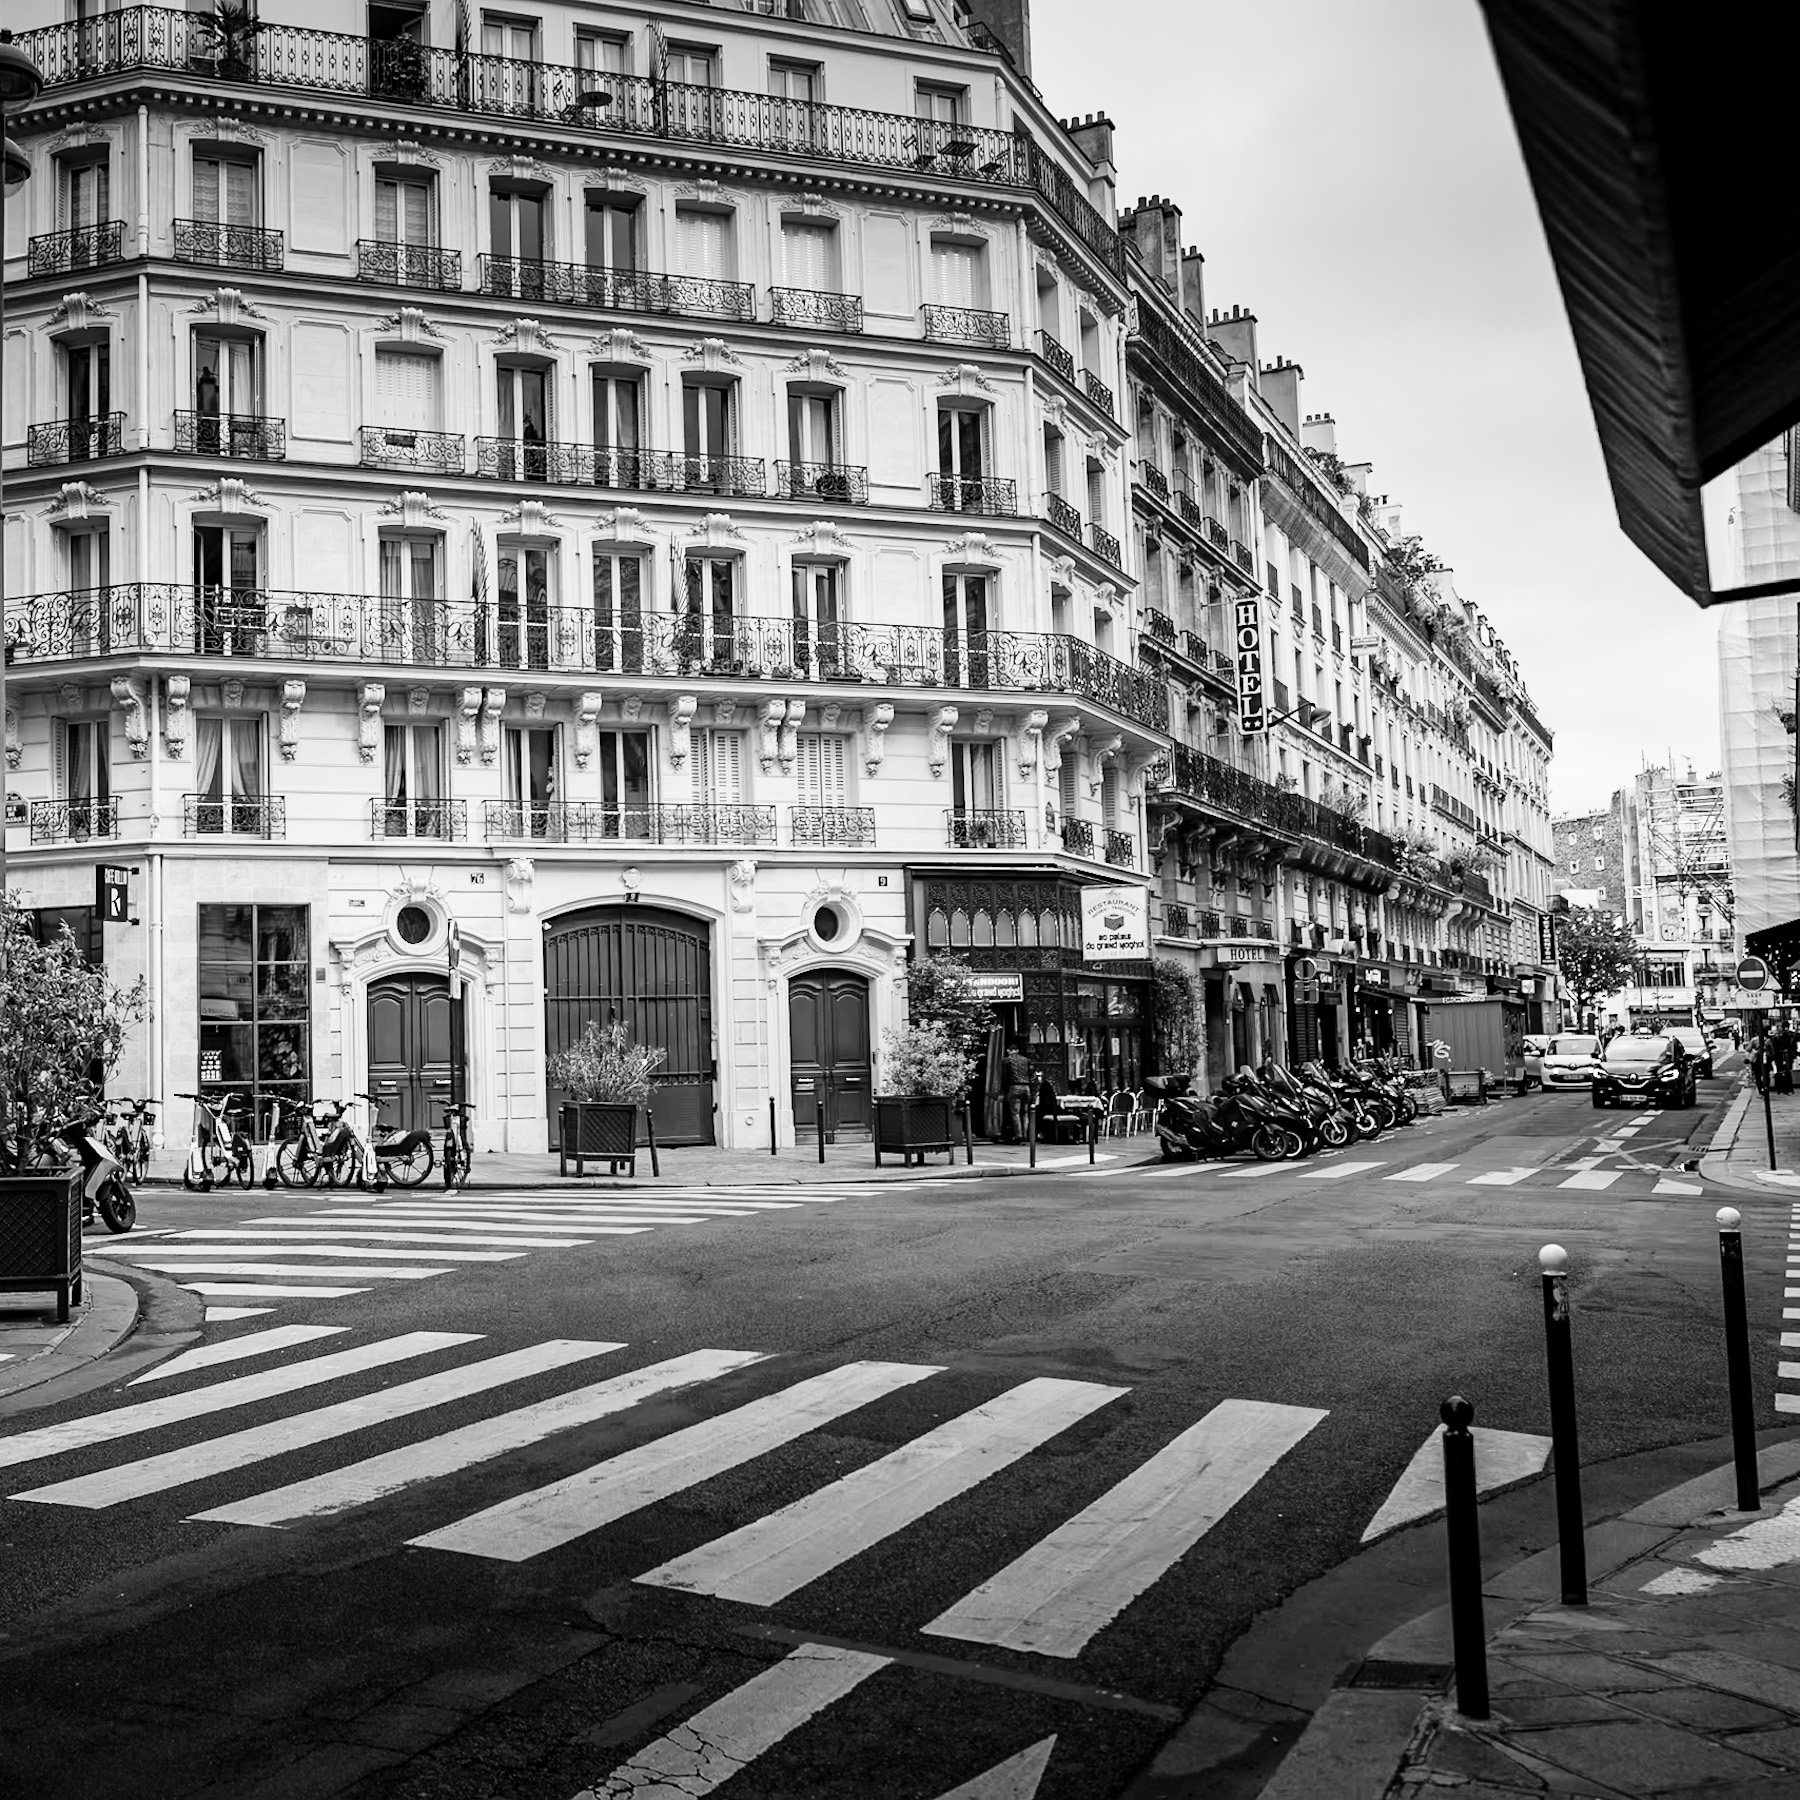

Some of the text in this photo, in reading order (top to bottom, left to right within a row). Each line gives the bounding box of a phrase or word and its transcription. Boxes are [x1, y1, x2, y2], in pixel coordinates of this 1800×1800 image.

[1236, 604, 1262, 718] HOTEL
[471, 873, 484, 884] 76
[111, 887, 121, 917] R
[1087, 899, 1140, 916] RESTAURANT
[1230, 948, 1265, 961] HOTEL
